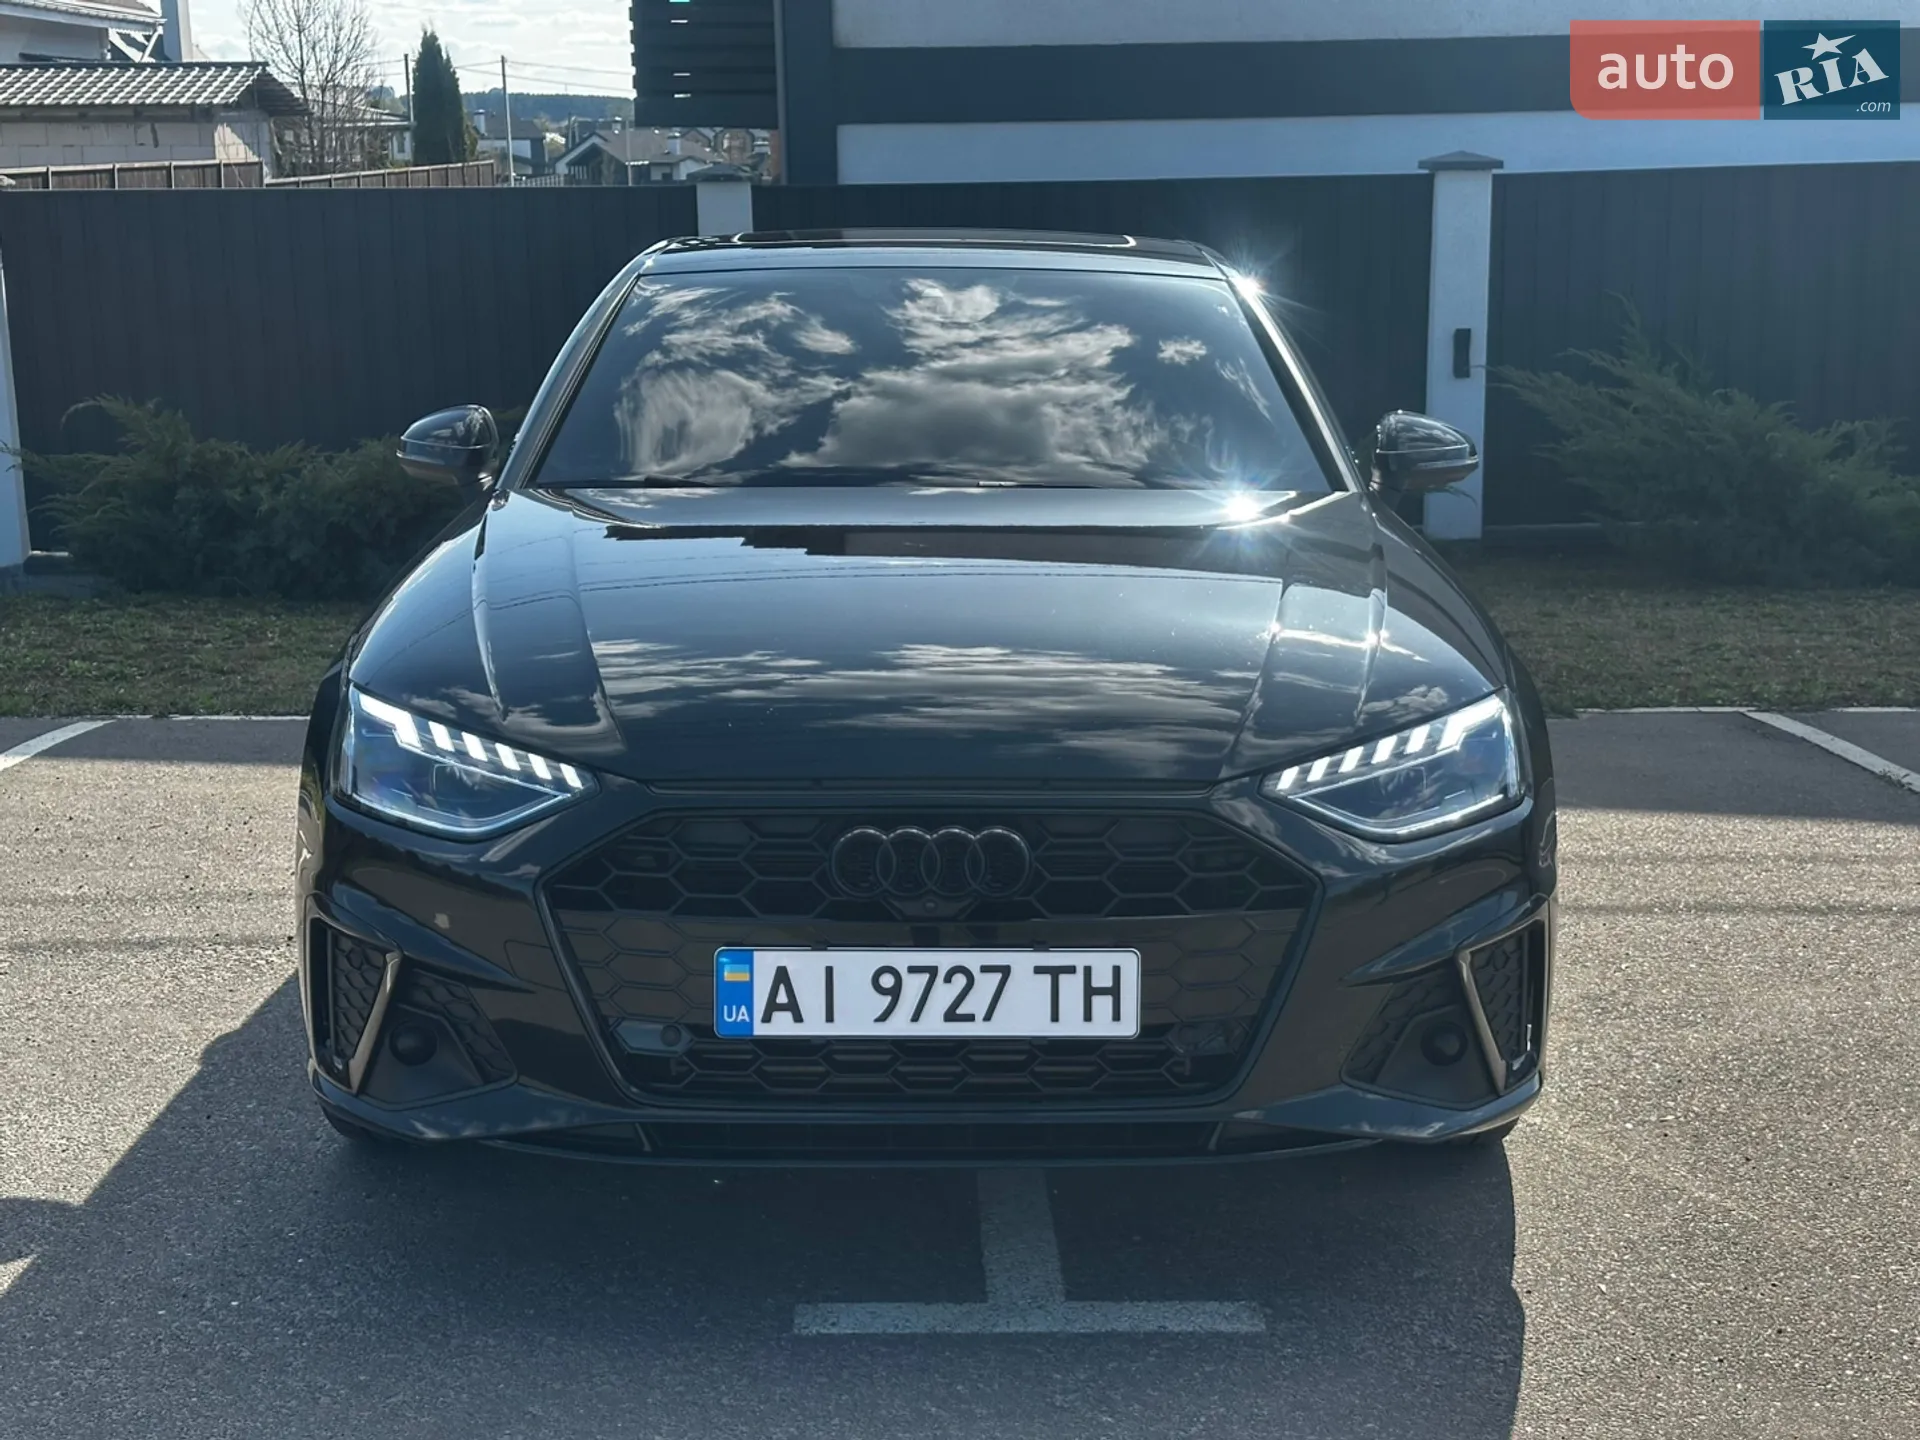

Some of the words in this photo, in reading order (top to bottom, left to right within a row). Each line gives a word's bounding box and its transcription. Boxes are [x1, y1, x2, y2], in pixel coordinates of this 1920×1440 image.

[870, 965, 1012, 1023] 9727
[1033, 965, 1122, 1023] TH
[723, 1005, 750, 1023] UA
